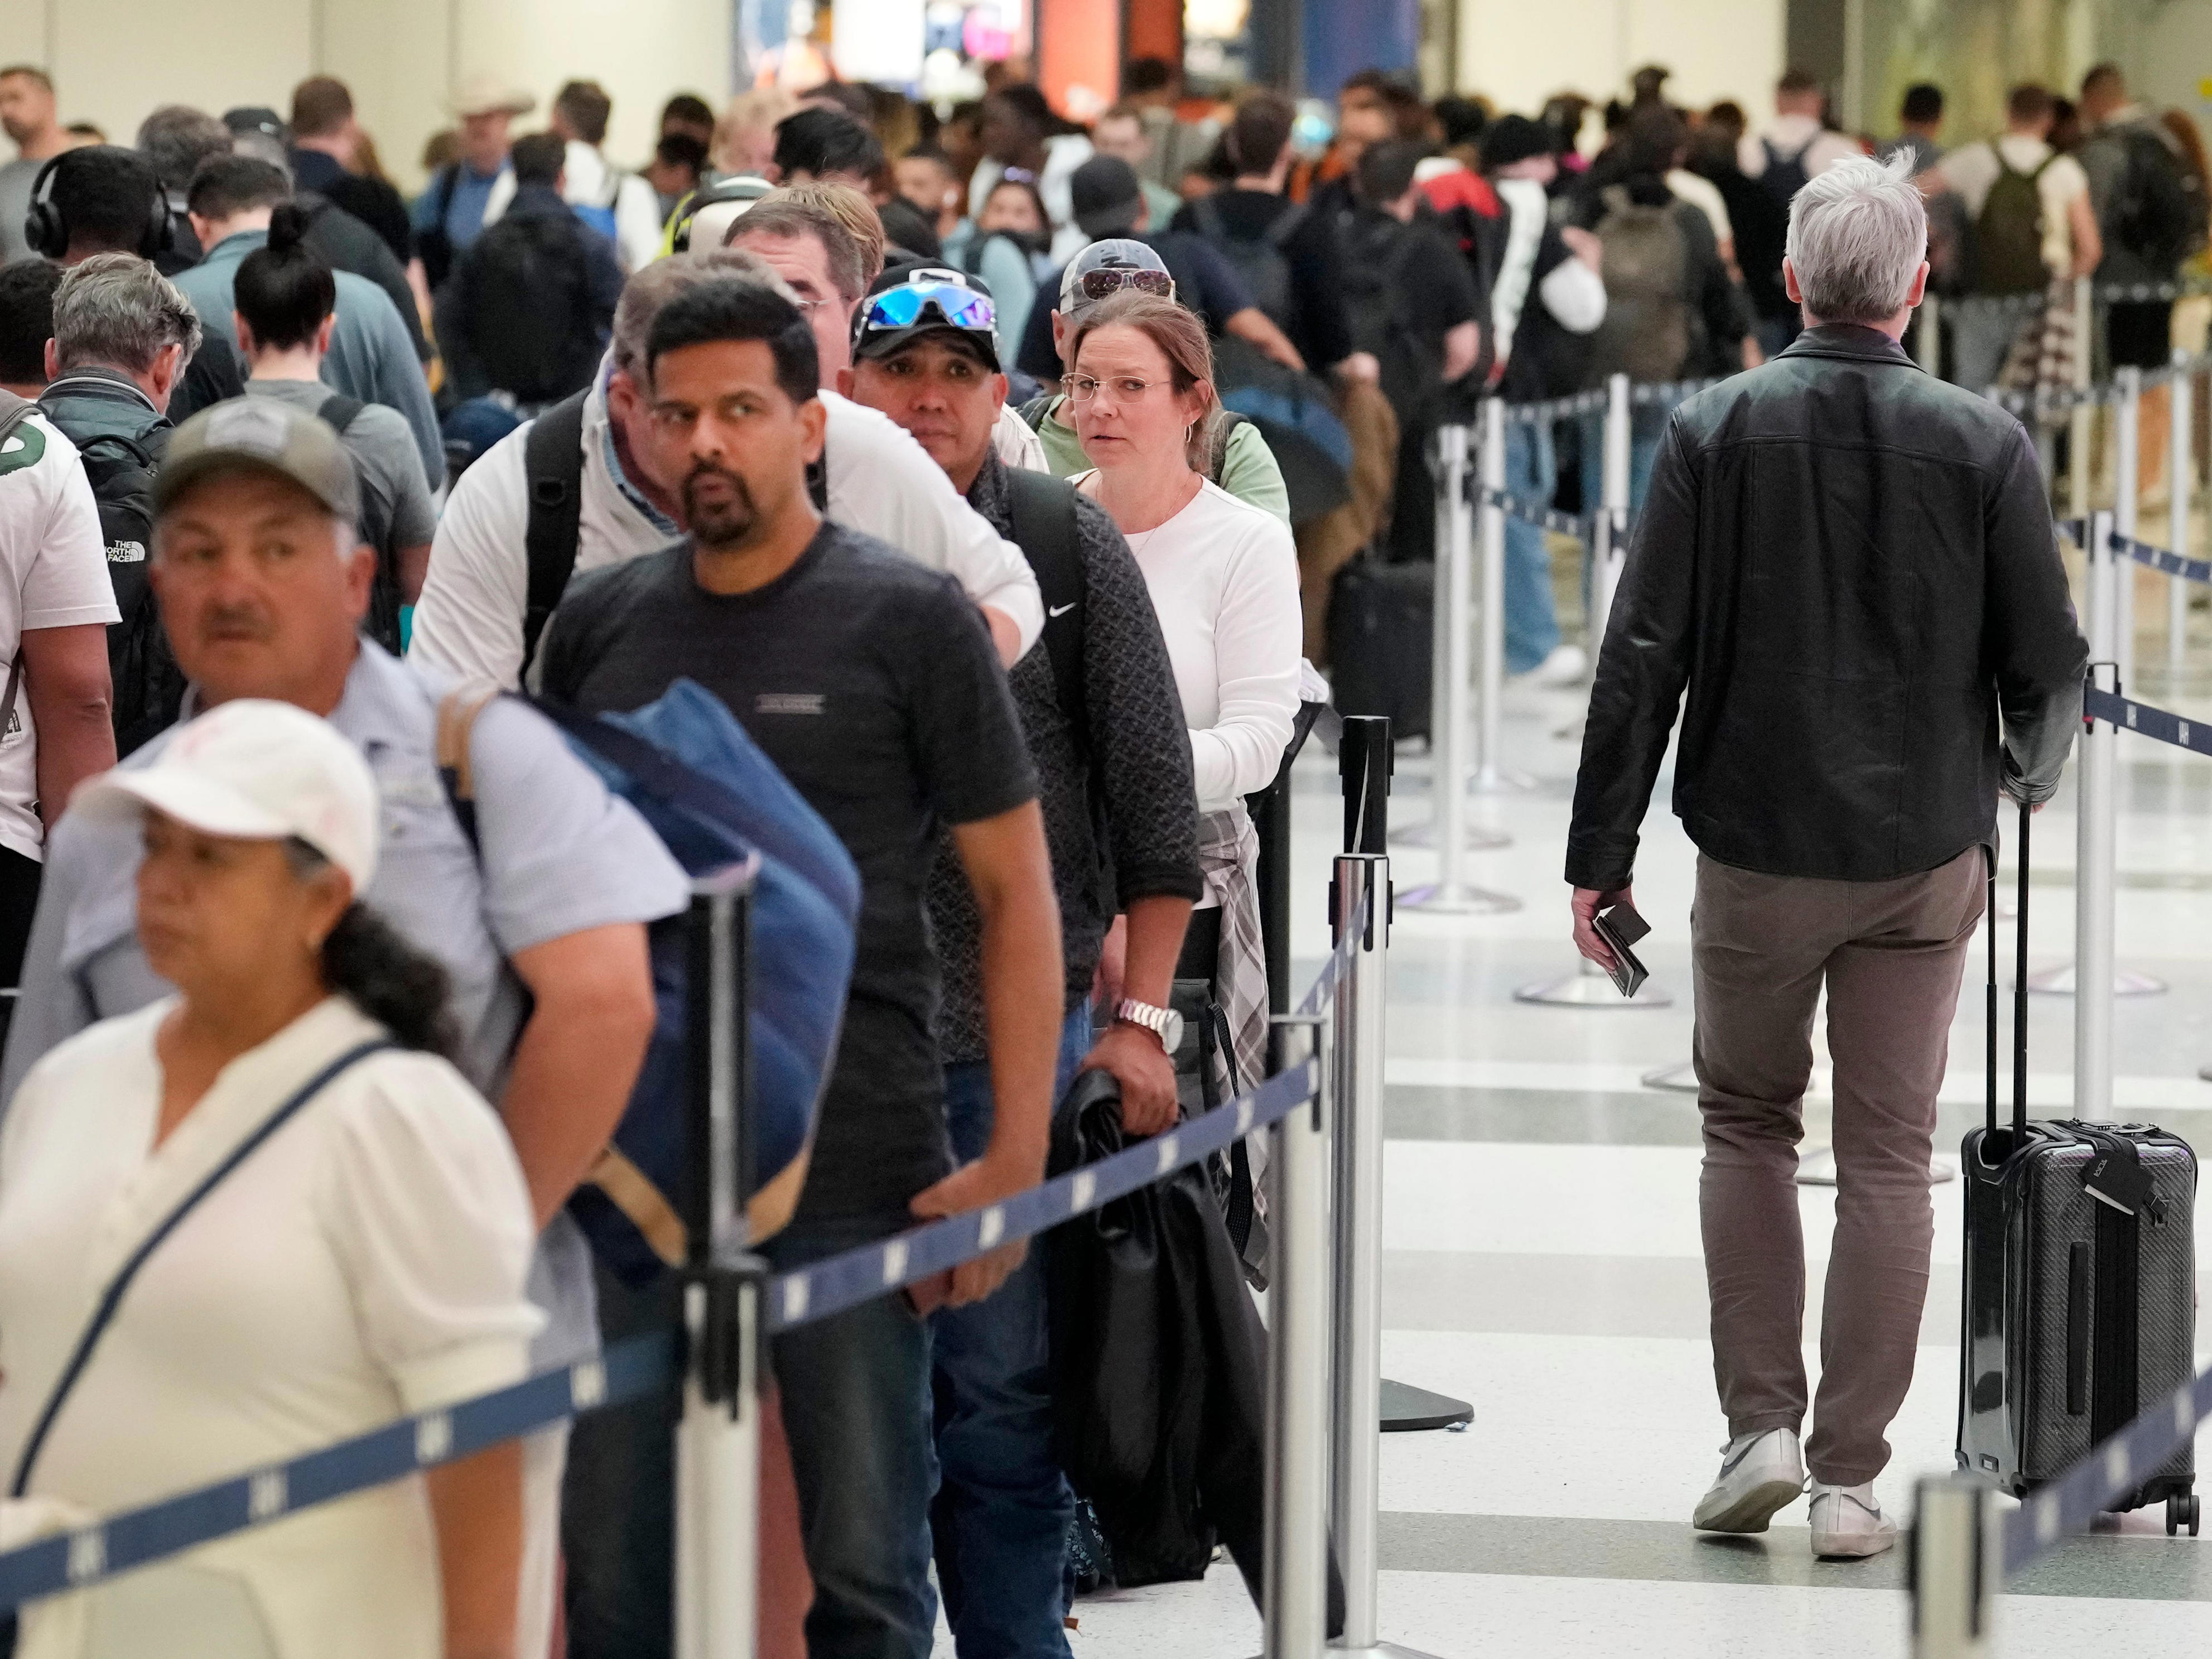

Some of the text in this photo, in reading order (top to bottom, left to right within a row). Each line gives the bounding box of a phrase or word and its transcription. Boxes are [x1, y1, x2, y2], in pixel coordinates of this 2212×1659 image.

[114, 540, 132, 548] THE
[105, 546, 131, 556] ORTH
[107, 554, 130, 562] FACE
